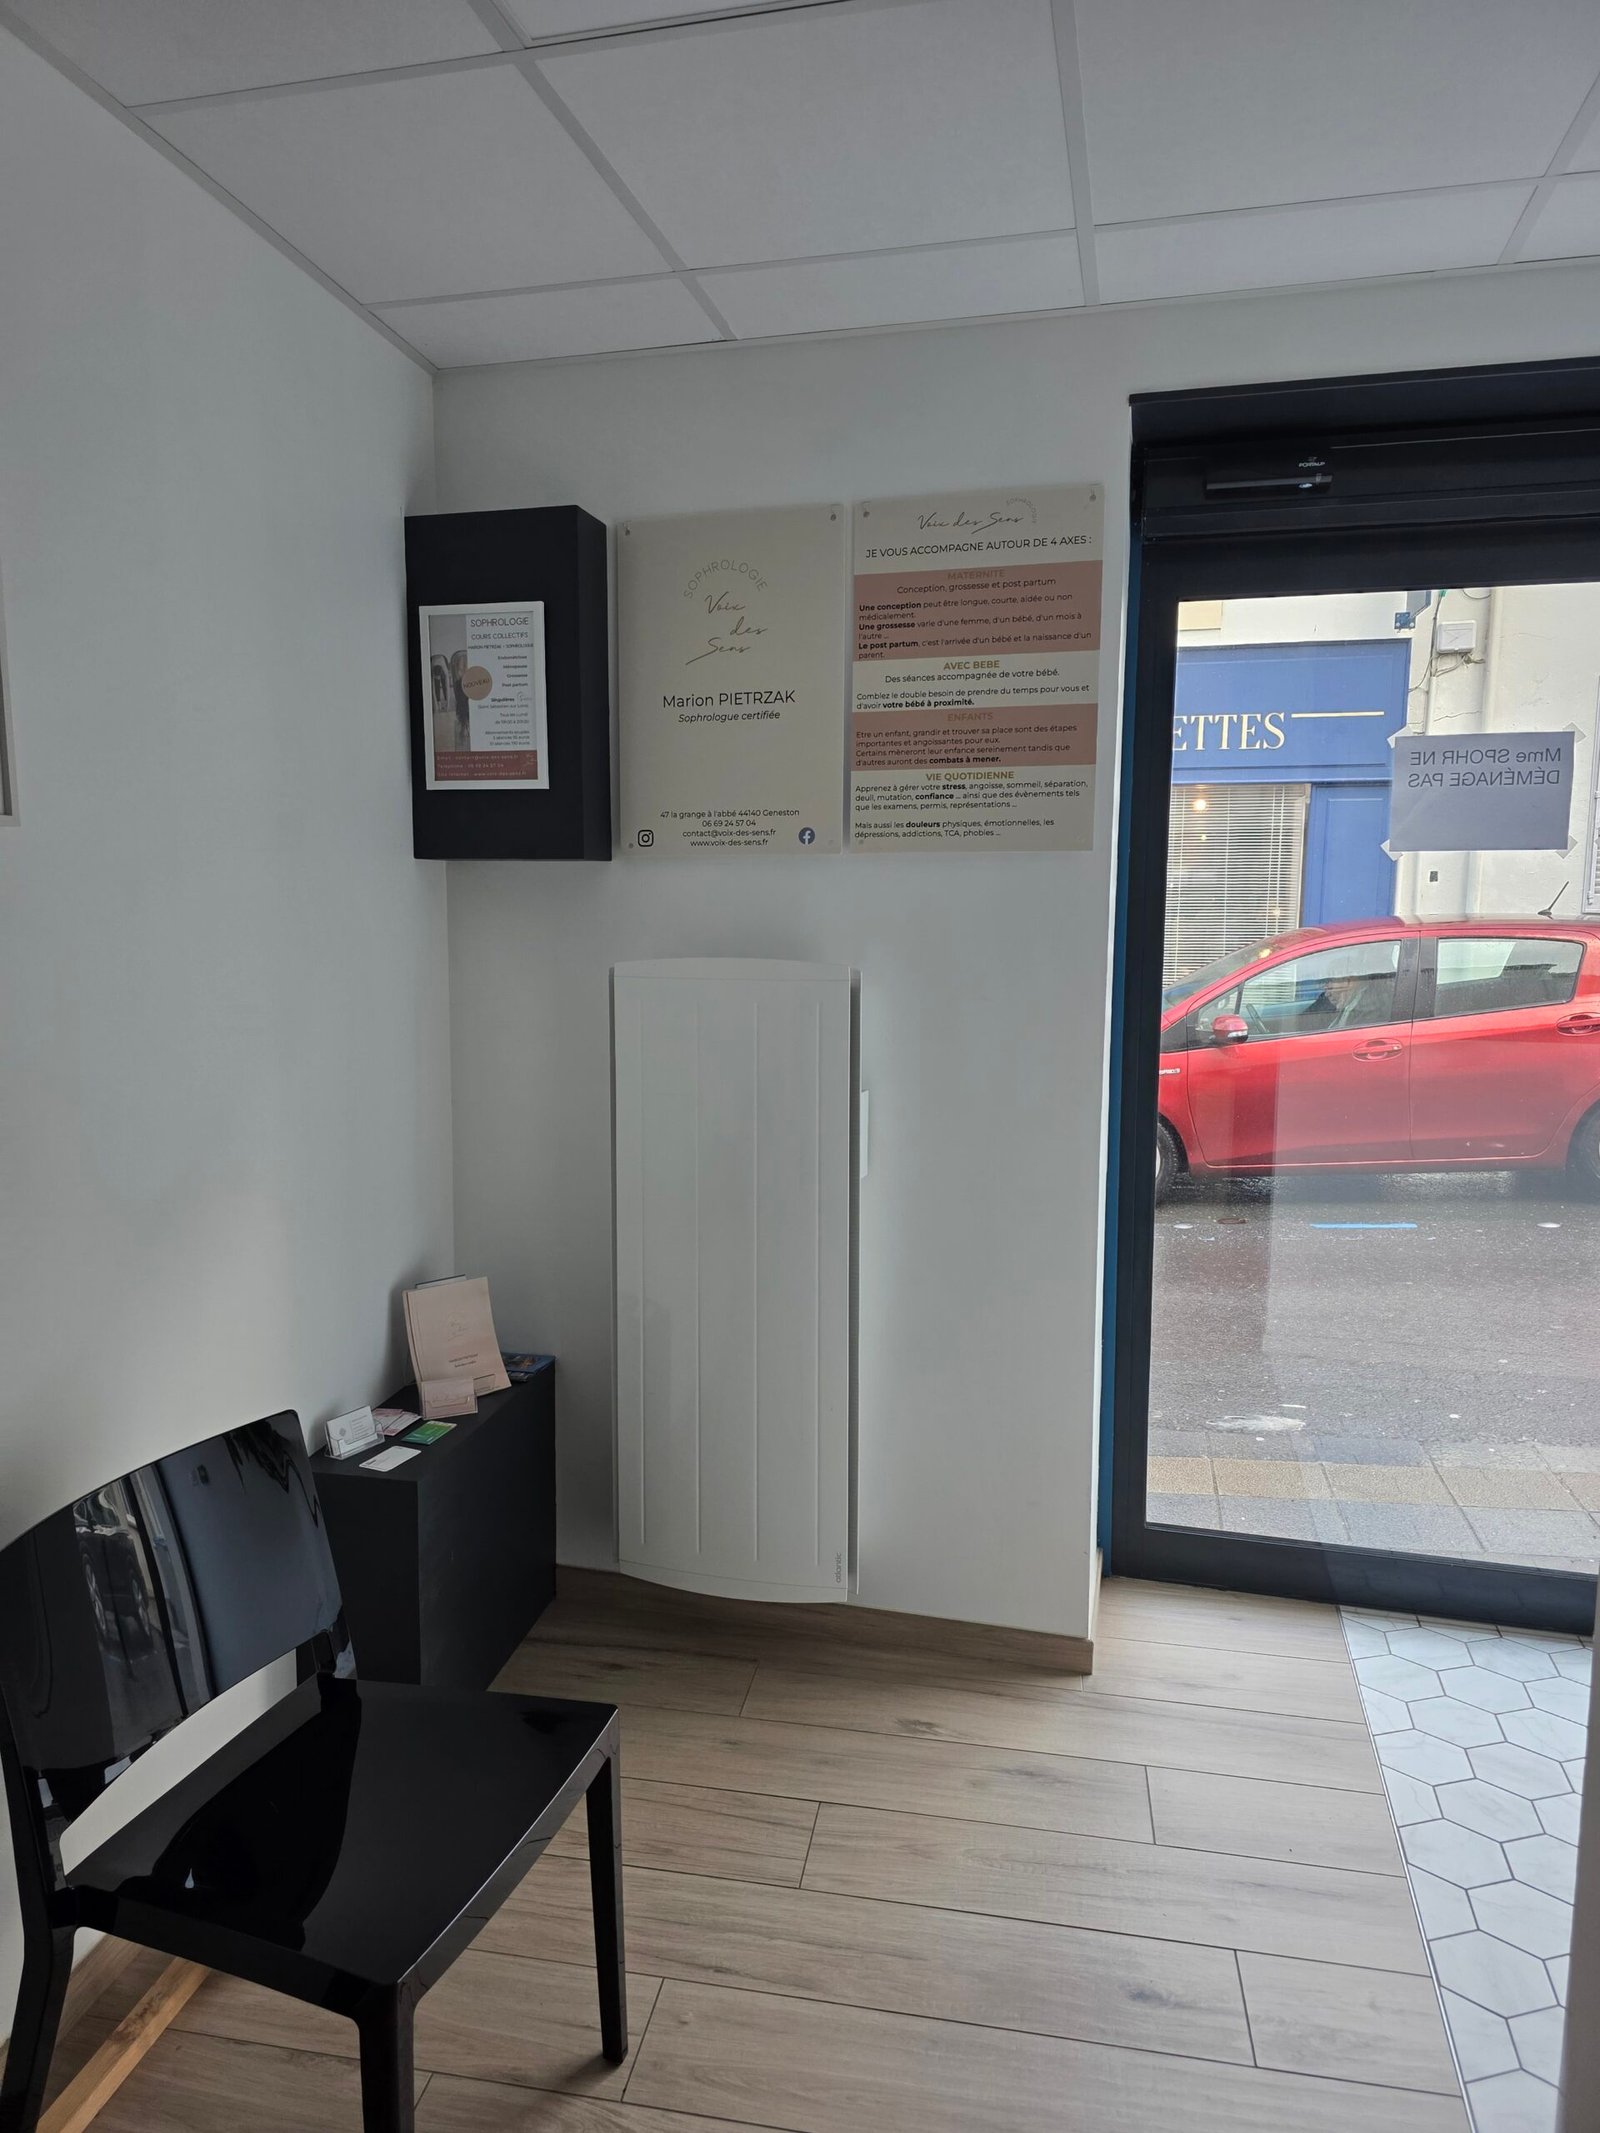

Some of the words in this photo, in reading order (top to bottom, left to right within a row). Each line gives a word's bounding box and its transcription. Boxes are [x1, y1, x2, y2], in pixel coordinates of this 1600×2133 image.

[918, 512, 950, 530] Voix
[952, 511, 983, 527] des
[971, 512, 1024, 535] Sens
[866, 548, 877, 558] JE
[879, 546, 908, 557] VOUS
[909, 542, 984, 556] ACCOMPAGNE
[986, 538, 1031, 551] AUTOUR
[1033, 537, 1048, 548] DE
[1050, 537, 1057, 546] 4
[1059, 535, 1087, 546] AXES
[683, 559, 768, 599] SOPHROLOGIE
[896, 584, 947, 594] Conception,
[948, 583, 990, 592] grossesse
[991, 581, 1001, 589] et
[1002, 580, 1021, 590] post
[1023, 578, 1056, 588] partum
[704, 591, 746, 615] Voix
[858, 604, 875, 612] Une
[876, 600, 922, 612] conception
[923, 601, 942, 609] peut
[960, 599, 990, 607] longue,
[991, 597, 1018, 605] courte,
[1020, 594, 1043, 603] aidée
[470, 616, 529, 628] SOPHROLOGIE
[730, 616, 768, 636] des
[858, 623, 875, 631] Une
[876, 622, 916, 631] grossesse
[917, 620, 935, 628] varie
[937, 619, 959, 627] d'une
[960, 617, 991, 626] femme,
[992, 616, 1010, 624] d'un
[1012, 614, 1034, 623] bébé,
[1035, 614, 1054, 622] d'un
[1055, 612, 1075, 620] mois
[1077, 612, 1082, 620] à
[858, 641, 869, 650] Le
[869, 642, 887, 651] post
[889, 641, 920, 650] partum,
[921, 639, 939, 647] c'est
[941, 637, 971, 646] l'arrivée
[991, 634, 1012, 644] bébé
[1032, 633, 1072, 641] naissance
[685, 637, 751, 666] Sens
[943, 661, 970, 671] AVEC
[973, 660, 1000, 669] BEBE
[885, 675, 901, 683] Des
[902, 674, 935, 683] séances
[937, 670, 997, 681] accompagnée
[998, 670, 1010, 679] de
[1011, 670, 1034, 678] votre
[1035, 668, 1059, 677] bébé.
[663, 693, 714, 708] Marion
[719, 690, 795, 706] PIETRZAK
[856, 692, 890, 701] Comblez
[899, 690, 927, 699] double
[928, 689, 954, 698] besoin
[955, 689, 966, 697] de
[967, 688, 999, 697] prendre
[1000, 687, 1011, 695] du
[1012, 687, 1039, 695] temps
[1040, 686, 1059, 694] pour
[856, 702, 881, 710] d'avoir
[905, 700, 925, 708] bébé
[933, 698, 974, 708] proximité.
[678, 712, 739, 724] Sophrologue
[741, 710, 780, 721] certifiée
[1173, 712, 1285, 751] ETTES
[925, 773, 942, 781] VIE
[944, 771, 1014, 782] QUOTIDIENNE
[701, 820, 712, 828] 06
[713, 819, 723, 827] 69
[724, 819, 734, 827] 24
[735, 819, 745, 827] 57
[745, 819, 756, 827] 04
[873, 821, 892, 829] aussi
[905, 820, 941, 828] douleurs
[941, 820, 982, 829] physiques,
[984, 818, 1041, 827] émotionnelles,
